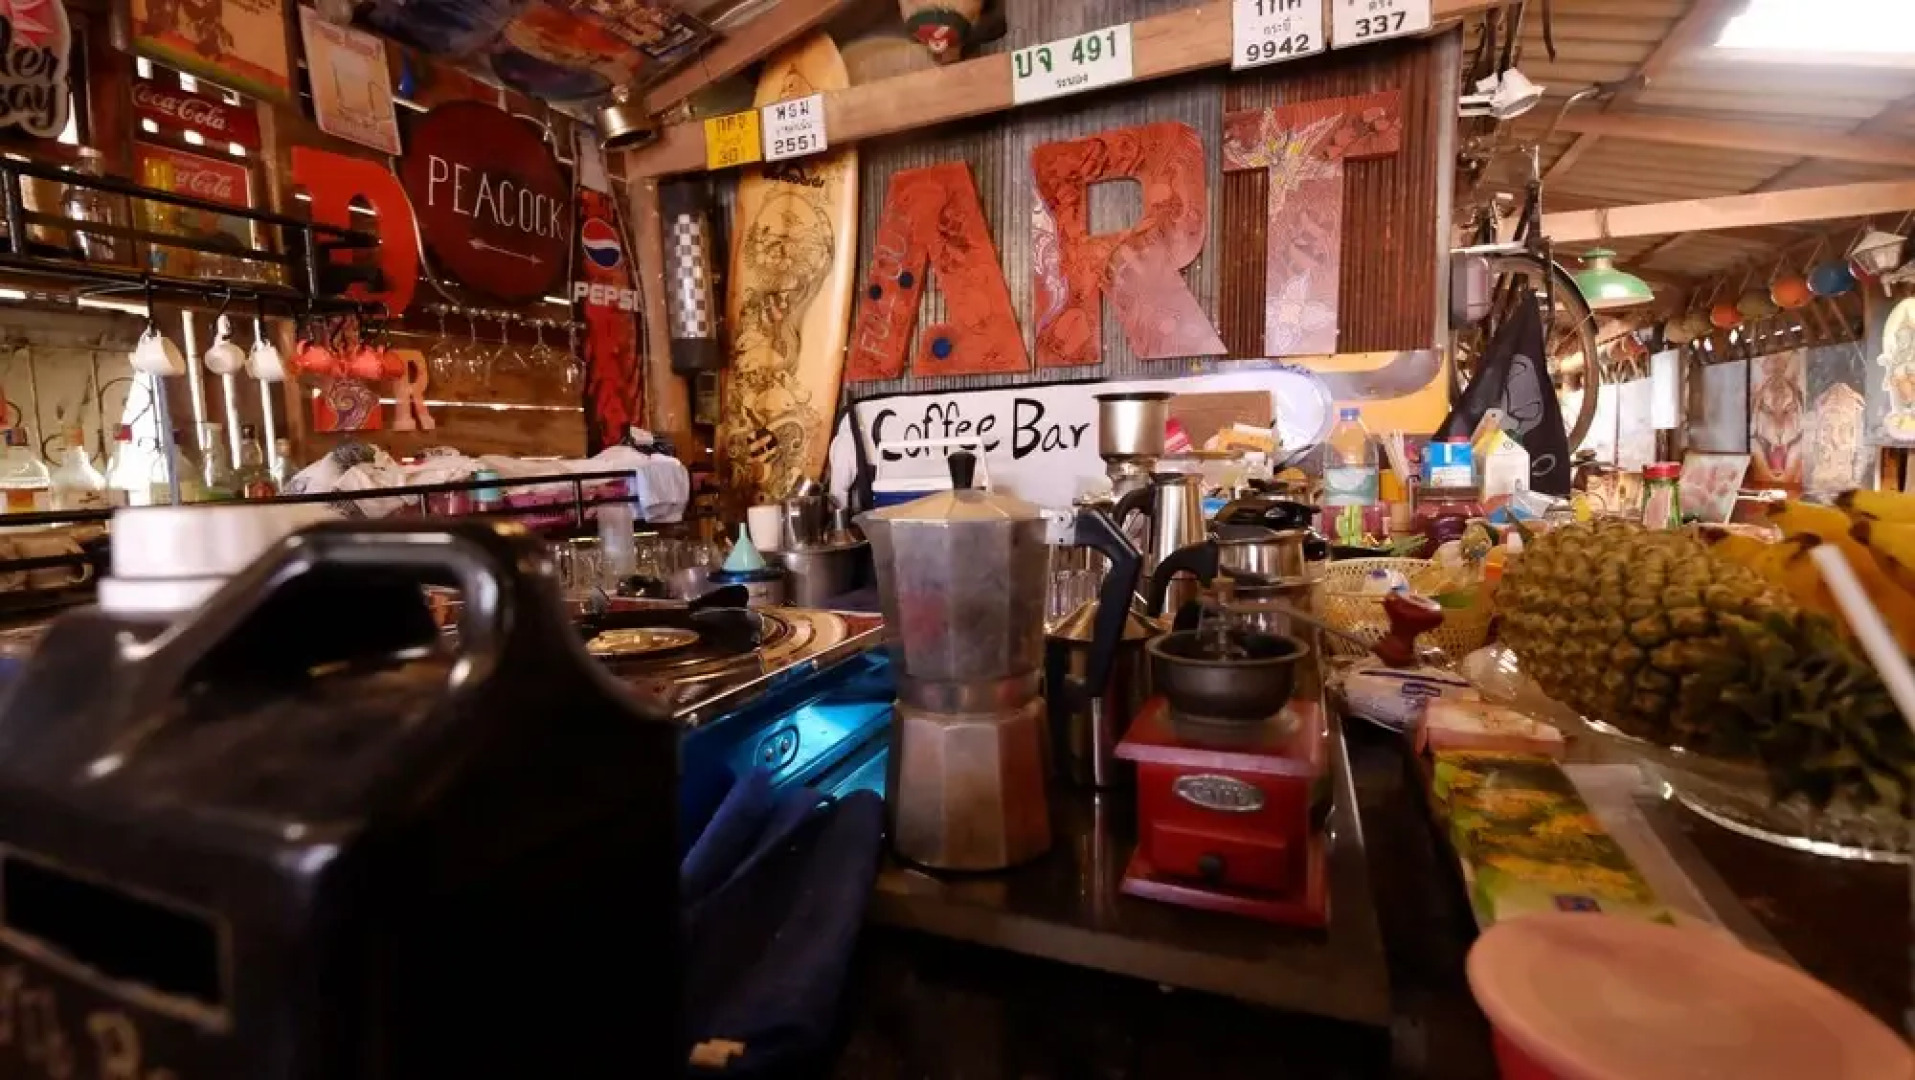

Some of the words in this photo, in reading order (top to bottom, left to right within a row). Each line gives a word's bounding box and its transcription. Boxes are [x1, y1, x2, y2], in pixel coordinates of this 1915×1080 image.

[1246, 33, 1310, 62] 9942
[1355, 11, 1406, 37] 337
[1015, 46, 1052, 78] บจ
[1071, 30, 1116, 65] 491
[428, 154, 565, 241] PEACOCK
[843, 90, 1401, 382] ART
[573, 281, 641, 312] PEPSI
[871, 399, 1001, 462] Coffee
[1012, 397, 1091, 460] Bar
